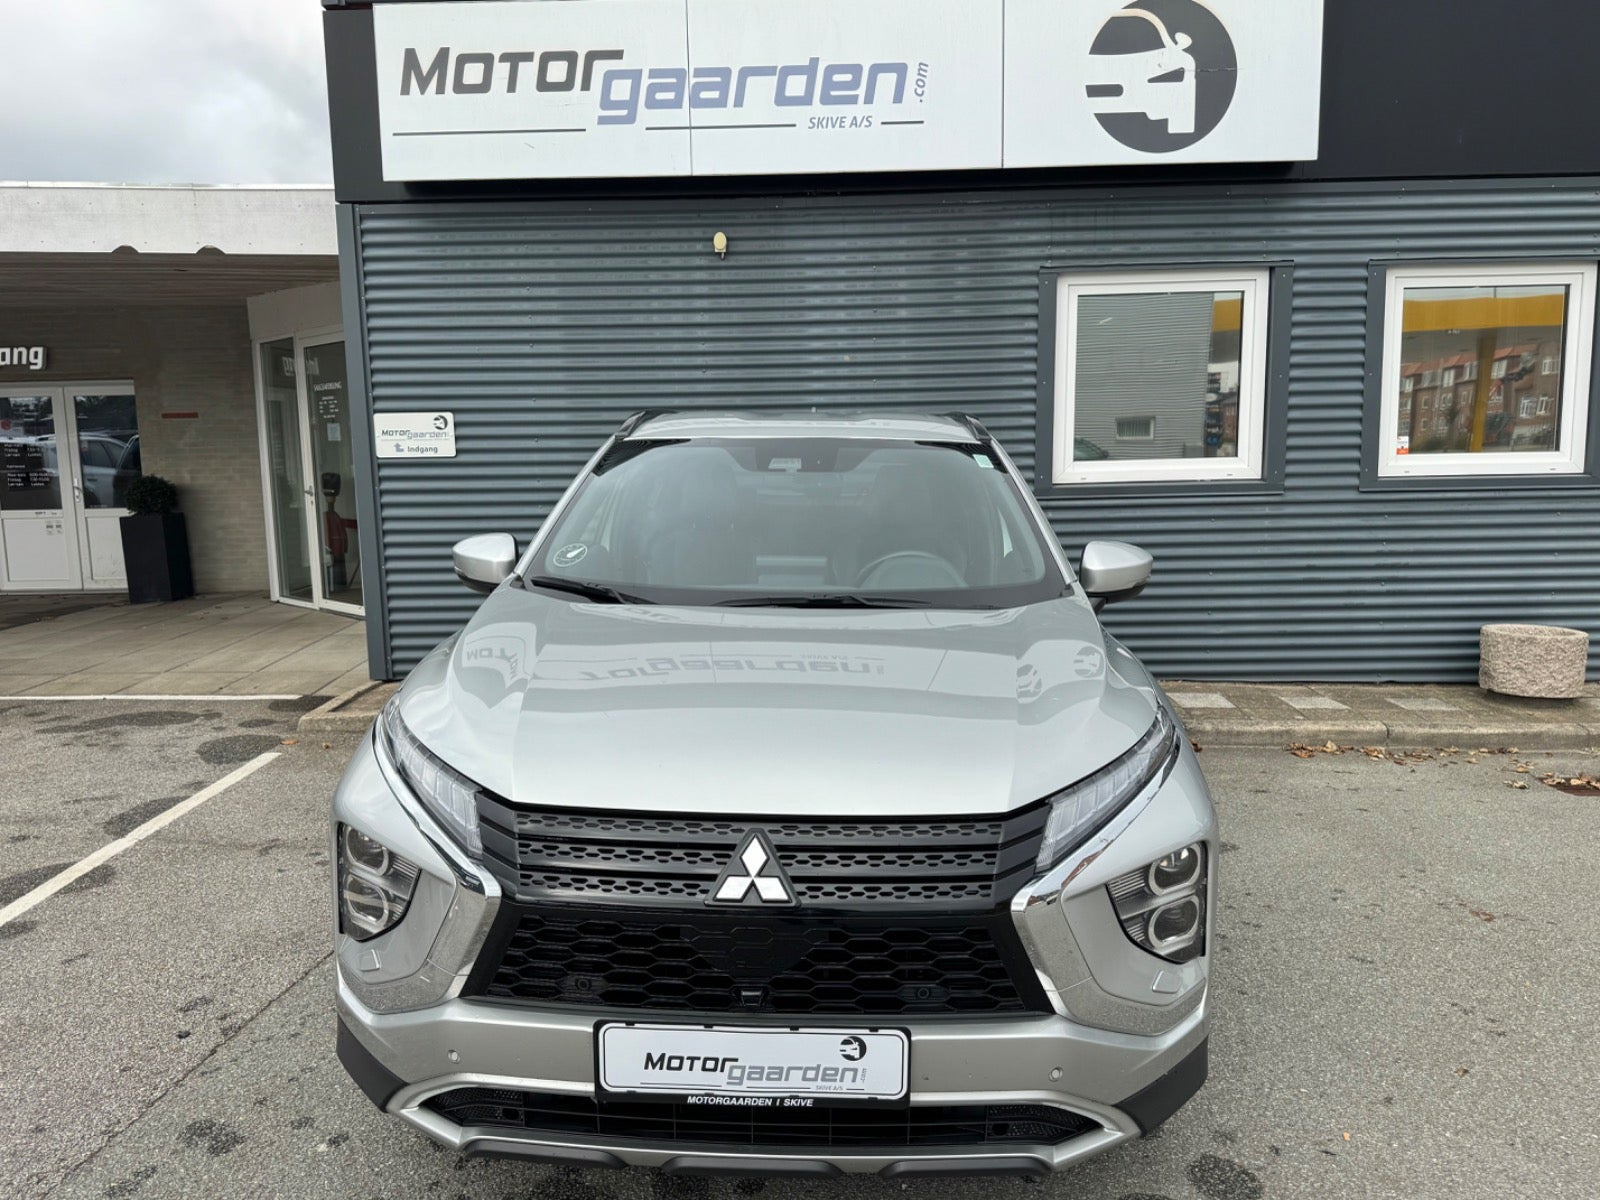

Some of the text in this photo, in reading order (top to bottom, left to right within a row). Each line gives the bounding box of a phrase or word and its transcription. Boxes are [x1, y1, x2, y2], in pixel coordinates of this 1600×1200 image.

[914, 62, 929, 103] .com
[808, 115, 873, 129] SKIVE A/S
[407, 445, 438, 454] Indgang
[687, 1096, 773, 1106] MOTORGAARDEN
[783, 1098, 814, 1107] SKIVE
